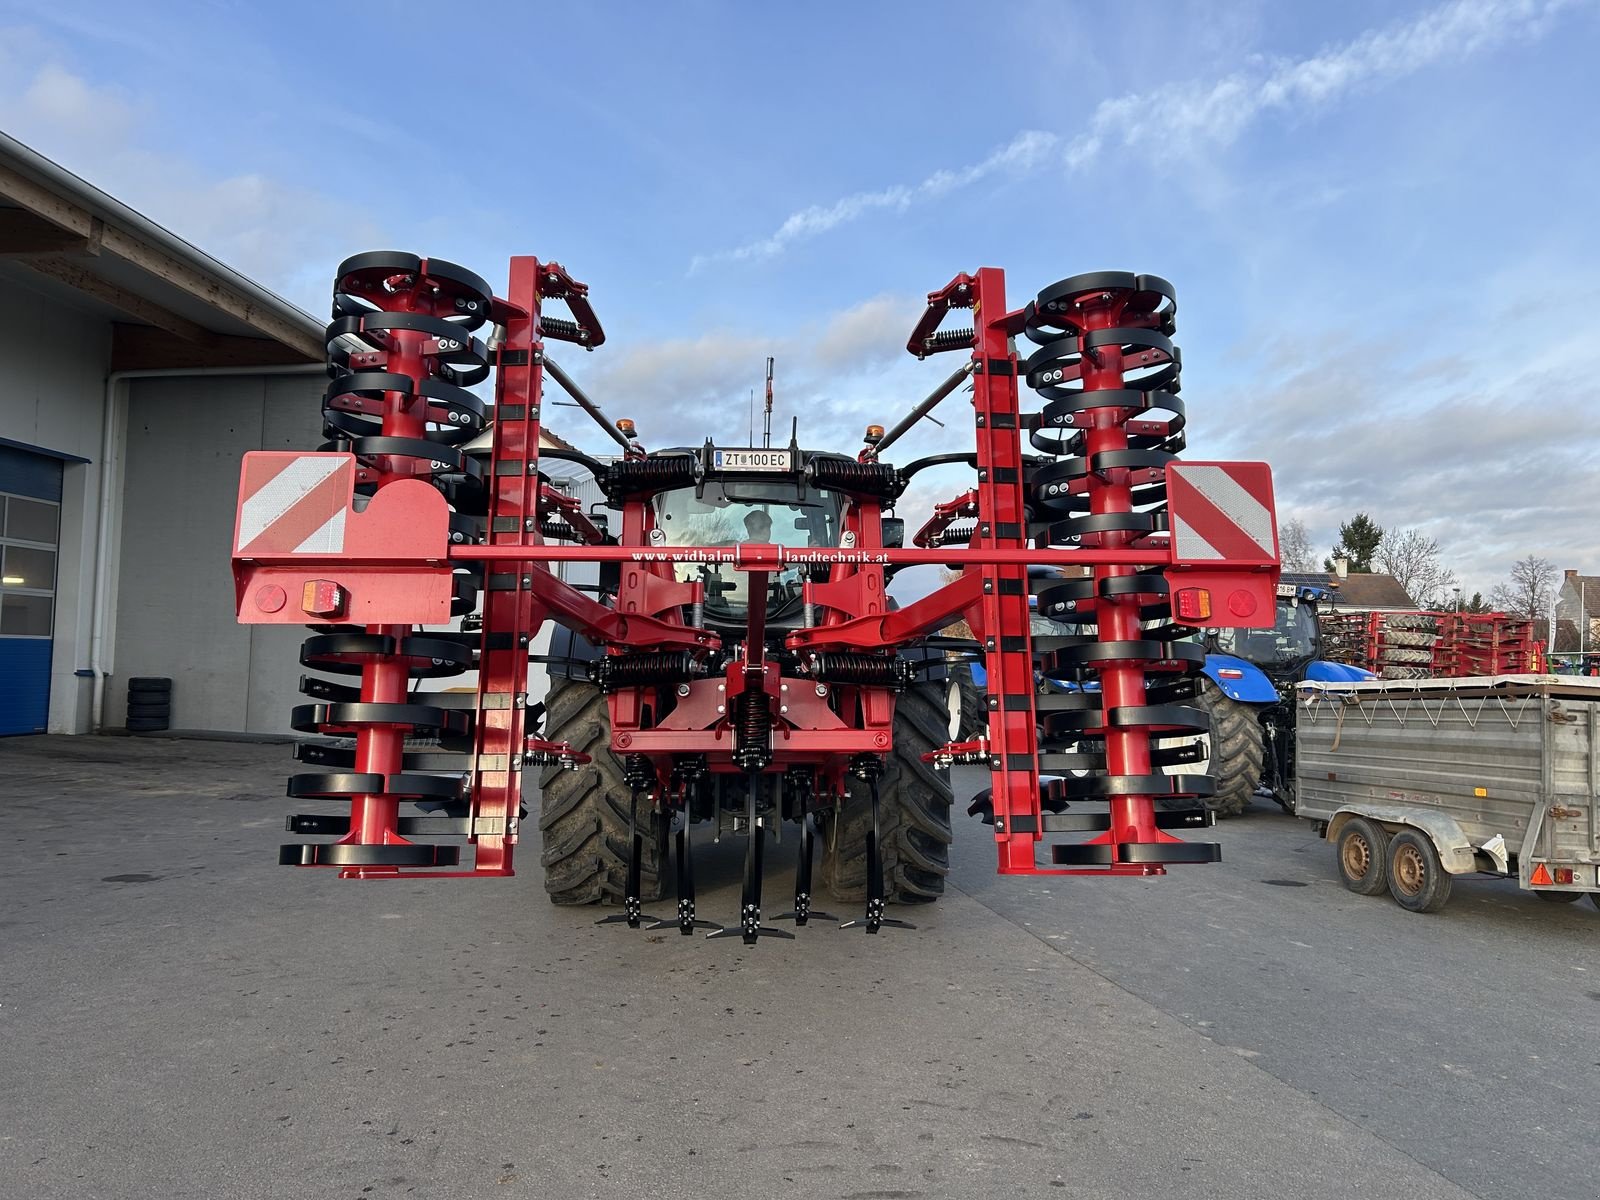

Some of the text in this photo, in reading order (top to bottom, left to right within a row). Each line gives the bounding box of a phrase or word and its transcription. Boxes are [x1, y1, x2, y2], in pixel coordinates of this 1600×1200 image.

[725, 453, 740, 465] ZT
[748, 454, 768, 466] 100
[770, 454, 785, 466] EC
[631, 550, 735, 561] www.widhalm
[785, 550, 889, 563] landtechnik.at
